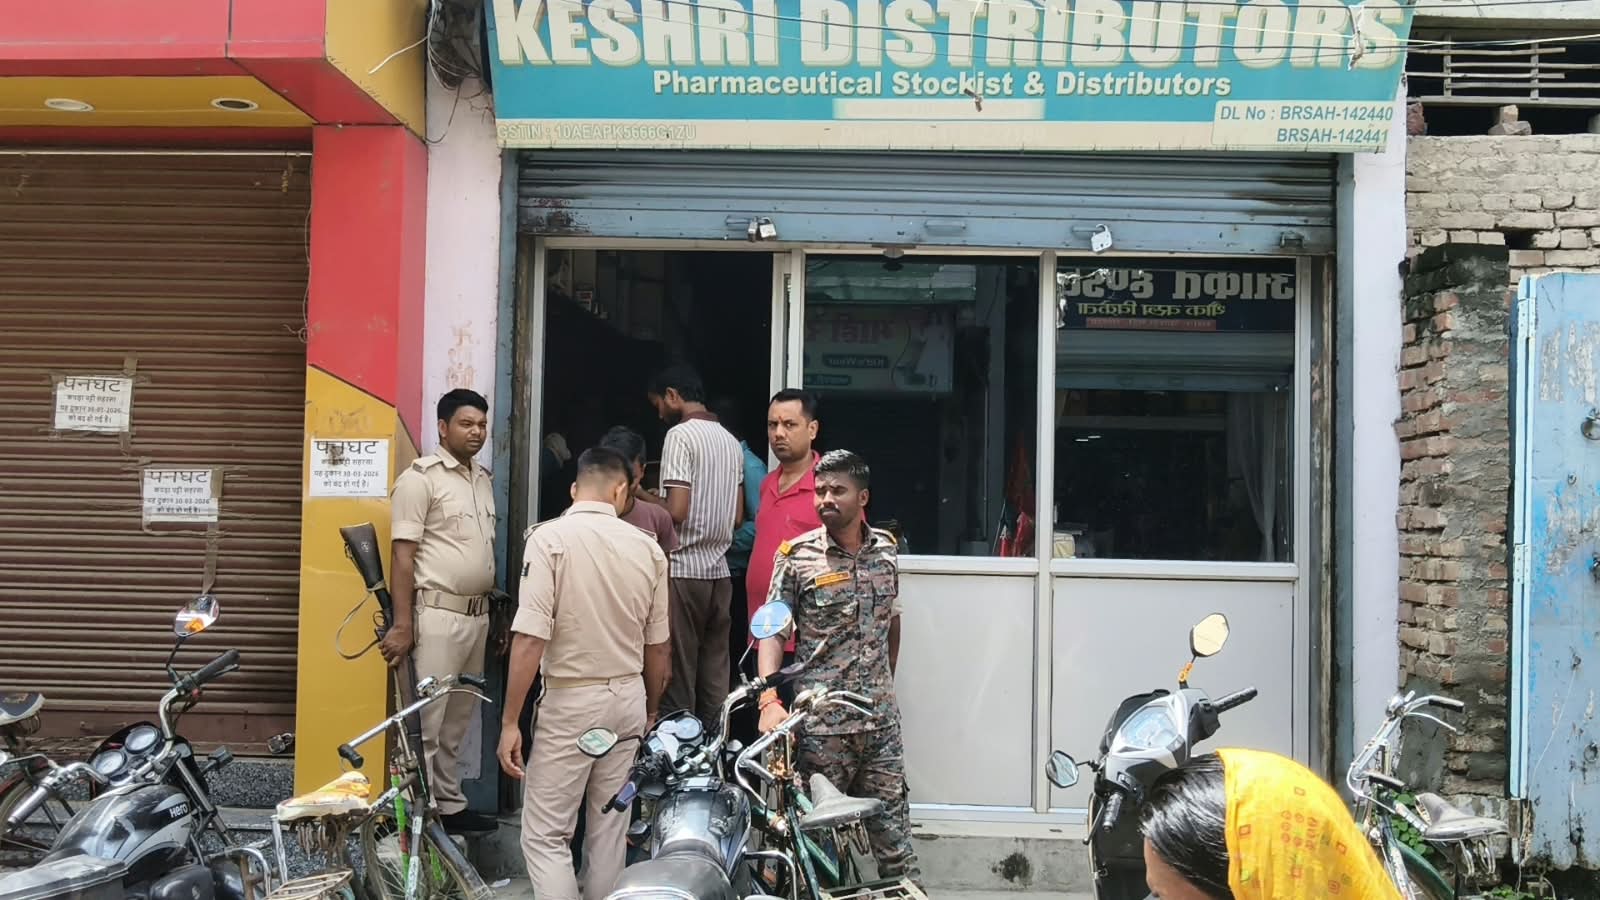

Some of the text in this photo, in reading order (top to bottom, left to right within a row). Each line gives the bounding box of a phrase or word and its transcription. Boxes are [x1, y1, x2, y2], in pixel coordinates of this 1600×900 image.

[494, 0, 1405, 70] KESHRI DISTRIBUTORS
[653, 70, 1232, 96] Pharmaceutical Stockist & Distributors
[1220, 106, 1240, 120] DL
[1245, 106, 1266, 120] No
[1280, 105, 1393, 121] BRSAH-142440
[1277, 127, 1389, 143] BRSAH-142441
[64, 376, 121, 392] पनघट
[169, 803, 188, 818] Hero
